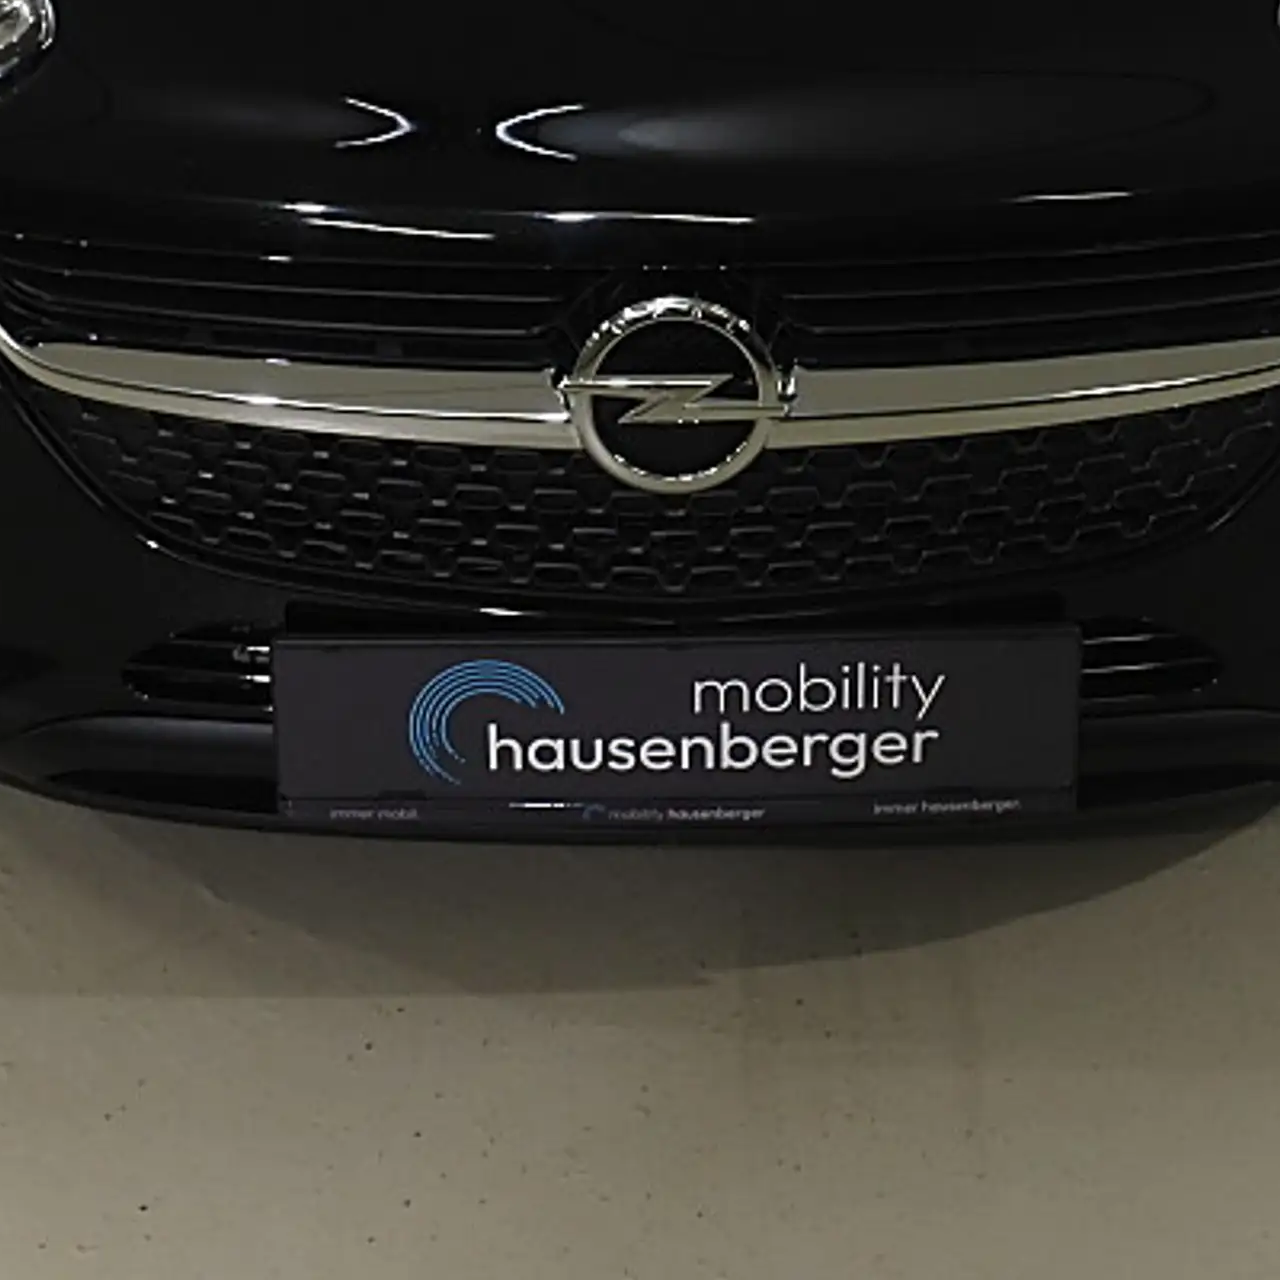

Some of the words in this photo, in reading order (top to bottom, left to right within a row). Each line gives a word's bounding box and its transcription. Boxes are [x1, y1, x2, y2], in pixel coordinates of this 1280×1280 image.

[693, 661, 945, 720] mobility
[487, 721, 940, 780] hausenberger
[668, 806, 766, 821] hausenberger
